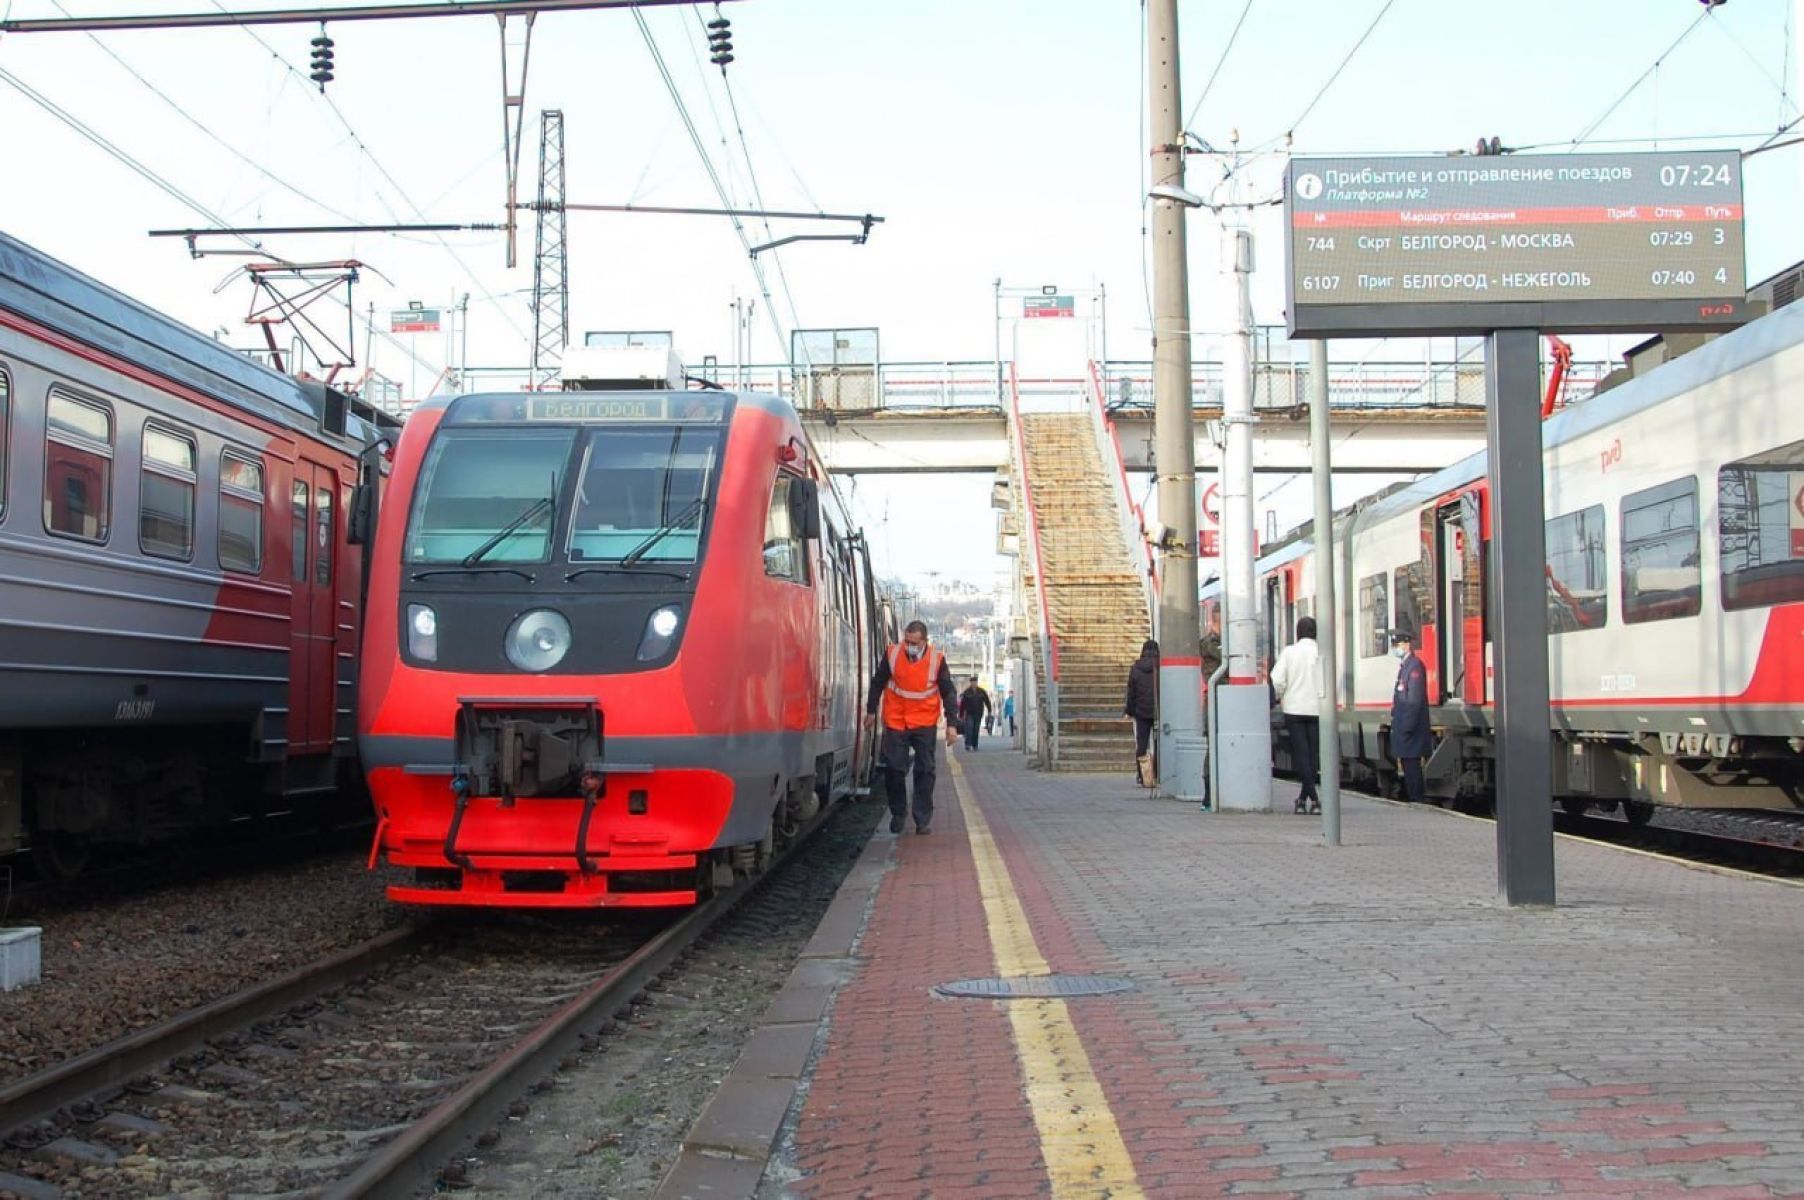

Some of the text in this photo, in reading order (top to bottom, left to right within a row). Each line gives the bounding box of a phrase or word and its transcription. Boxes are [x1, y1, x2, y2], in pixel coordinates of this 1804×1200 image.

[1325, 167, 1633, 186] Прибытие и отправление поездов
[1660, 164, 1732, 186] 07:24
[1327, 187, 1429, 202] Платформа №2
[1401, 211, 1516, 224] Маршрут следования
[1705, 206, 1732, 218] Путь
[1307, 237, 1335, 251] 744
[1357, 236, 1392, 251] Скрт
[1402, 235, 1487, 250] БЕЛГОРОД
[1501, 233, 1575, 248] МОСКВА
[1650, 231, 1693, 246] 07:29
[1713, 228, 1725, 245] 3
[1303, 276, 1340, 290] 6107
[1357, 275, 1394, 290] Приг
[1403, 273, 1488, 289] БЕЛГОРОД
[1501, 272, 1591, 287] НЕЖЕГОЛЬ
[1652, 270, 1695, 285] 07:40
[1715, 267, 1727, 284] 4
